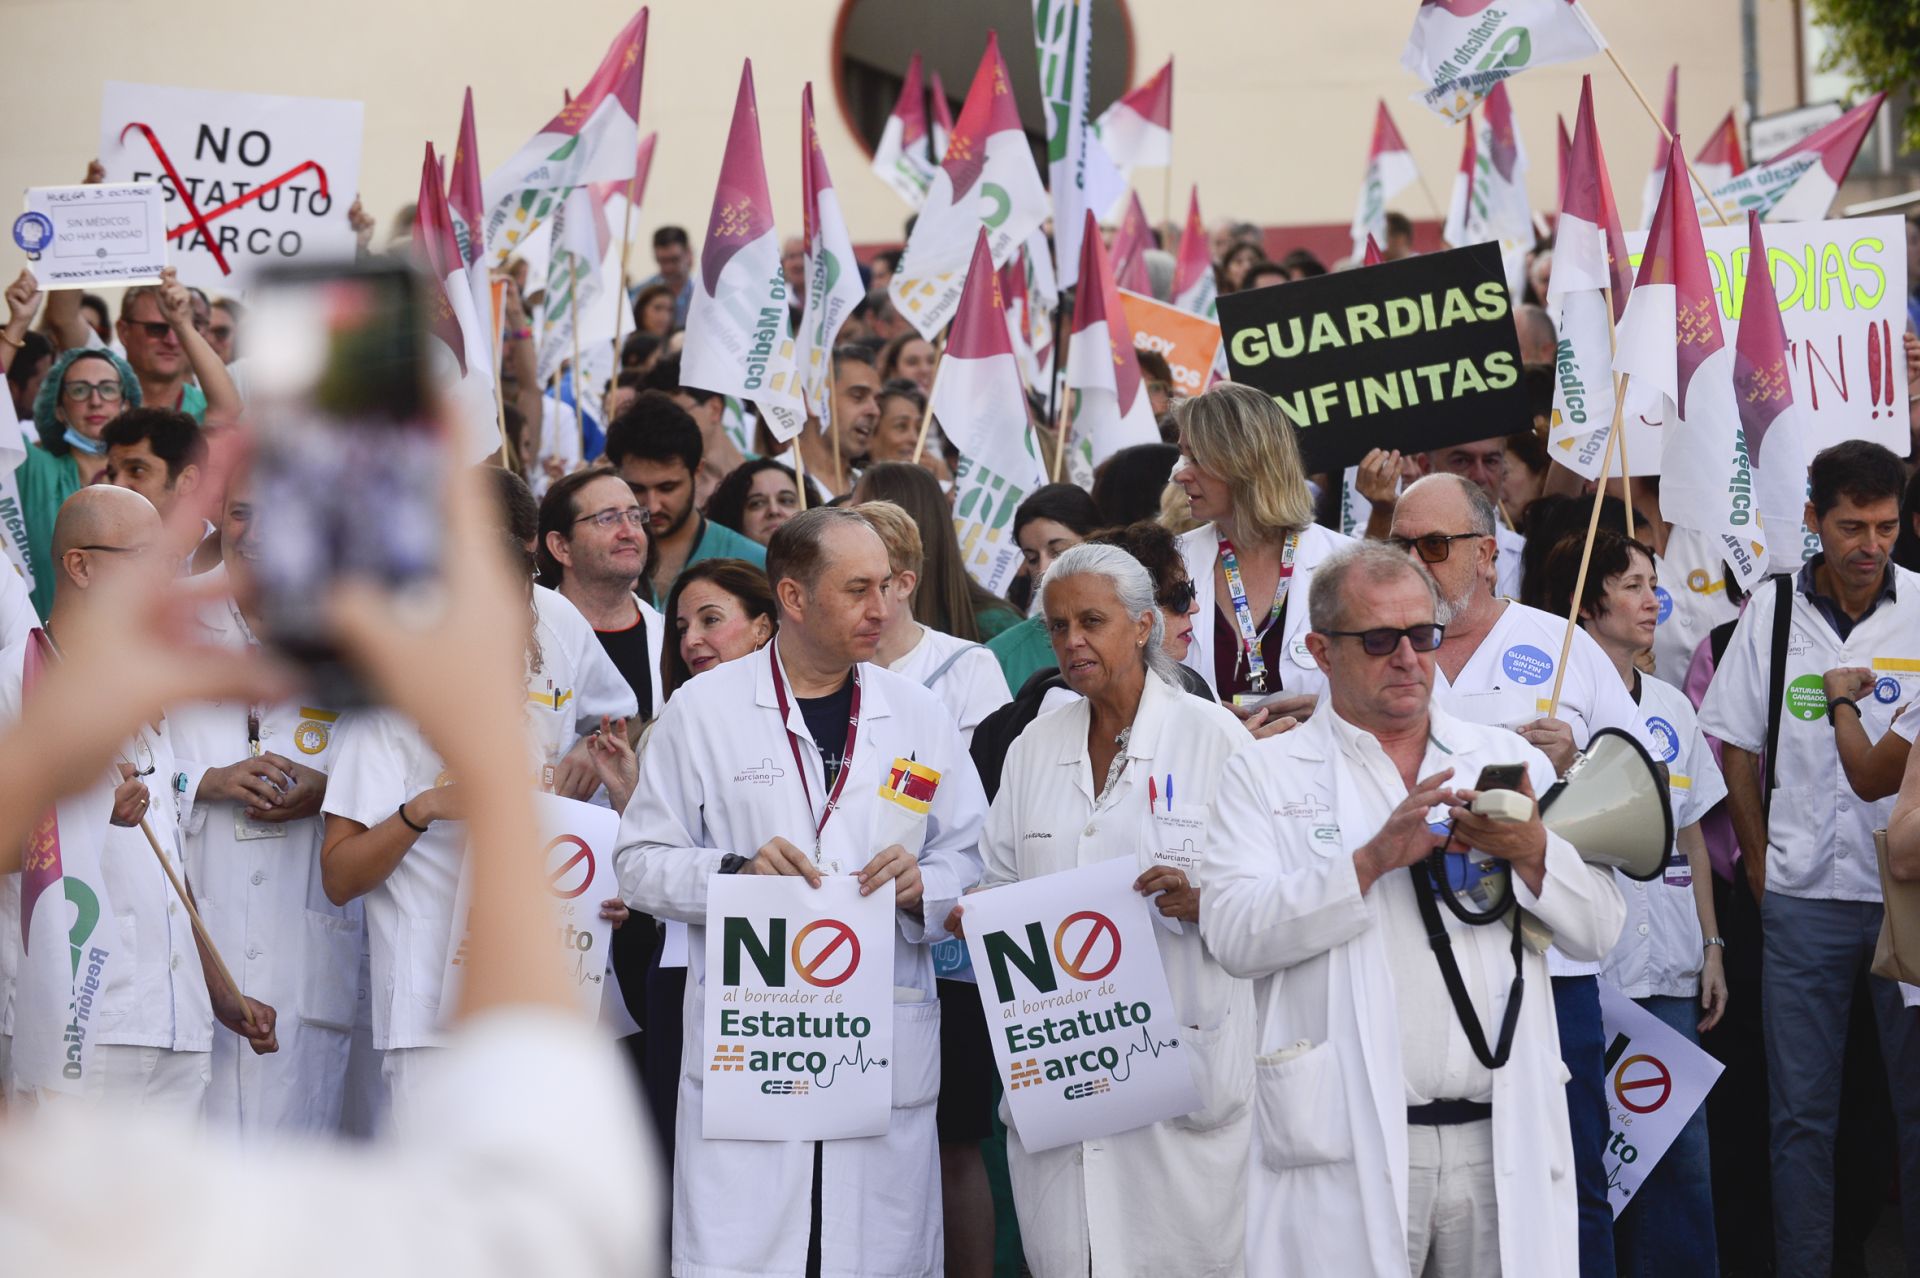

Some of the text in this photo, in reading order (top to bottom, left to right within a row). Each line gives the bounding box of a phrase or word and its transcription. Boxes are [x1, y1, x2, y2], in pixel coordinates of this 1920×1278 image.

[194, 124, 272, 167] NO
[1230, 282, 1507, 366] GUARDIAS
[1557, 338, 1587, 424] Médico
[1508, 650, 1551, 670] GUARDIAS
[1512, 659, 1542, 674] SIN FIN
[733, 774, 770, 783] Murciano
[1154, 851, 1191, 863] Murciano
[723, 988, 843, 1004] al borrador de
[1003, 981, 1116, 1020] al borrador de
[721, 1009, 871, 1038] Estatuto
[1005, 1000, 1152, 1054] Estatuto
[710, 1044, 827, 1073] Marco
[1011, 1046, 1119, 1091] Marco
